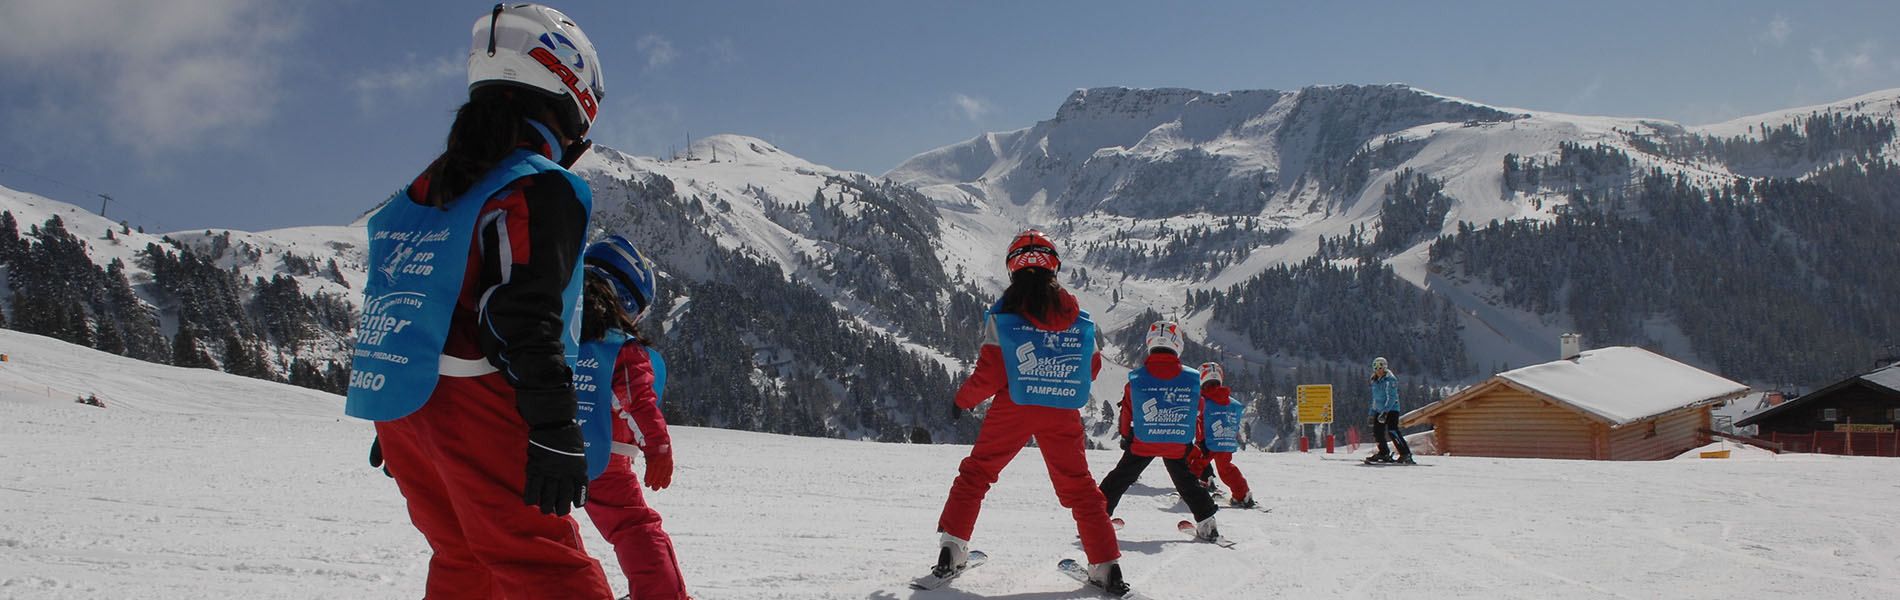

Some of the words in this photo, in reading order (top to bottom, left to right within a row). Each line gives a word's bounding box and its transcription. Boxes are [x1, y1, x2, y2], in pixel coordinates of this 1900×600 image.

[390, 231, 413, 241] noi
[416, 227, 450, 247] facile
[413, 252, 435, 263] BIP
[402, 263, 434, 276] CLUB
[403, 297, 423, 309] Italy
[1038, 356, 1057, 365] ski
[1038, 363, 1079, 372] center
[1026, 385, 1076, 396] PAMPEAGO
[1148, 428, 1186, 436] PAMPEAGO
